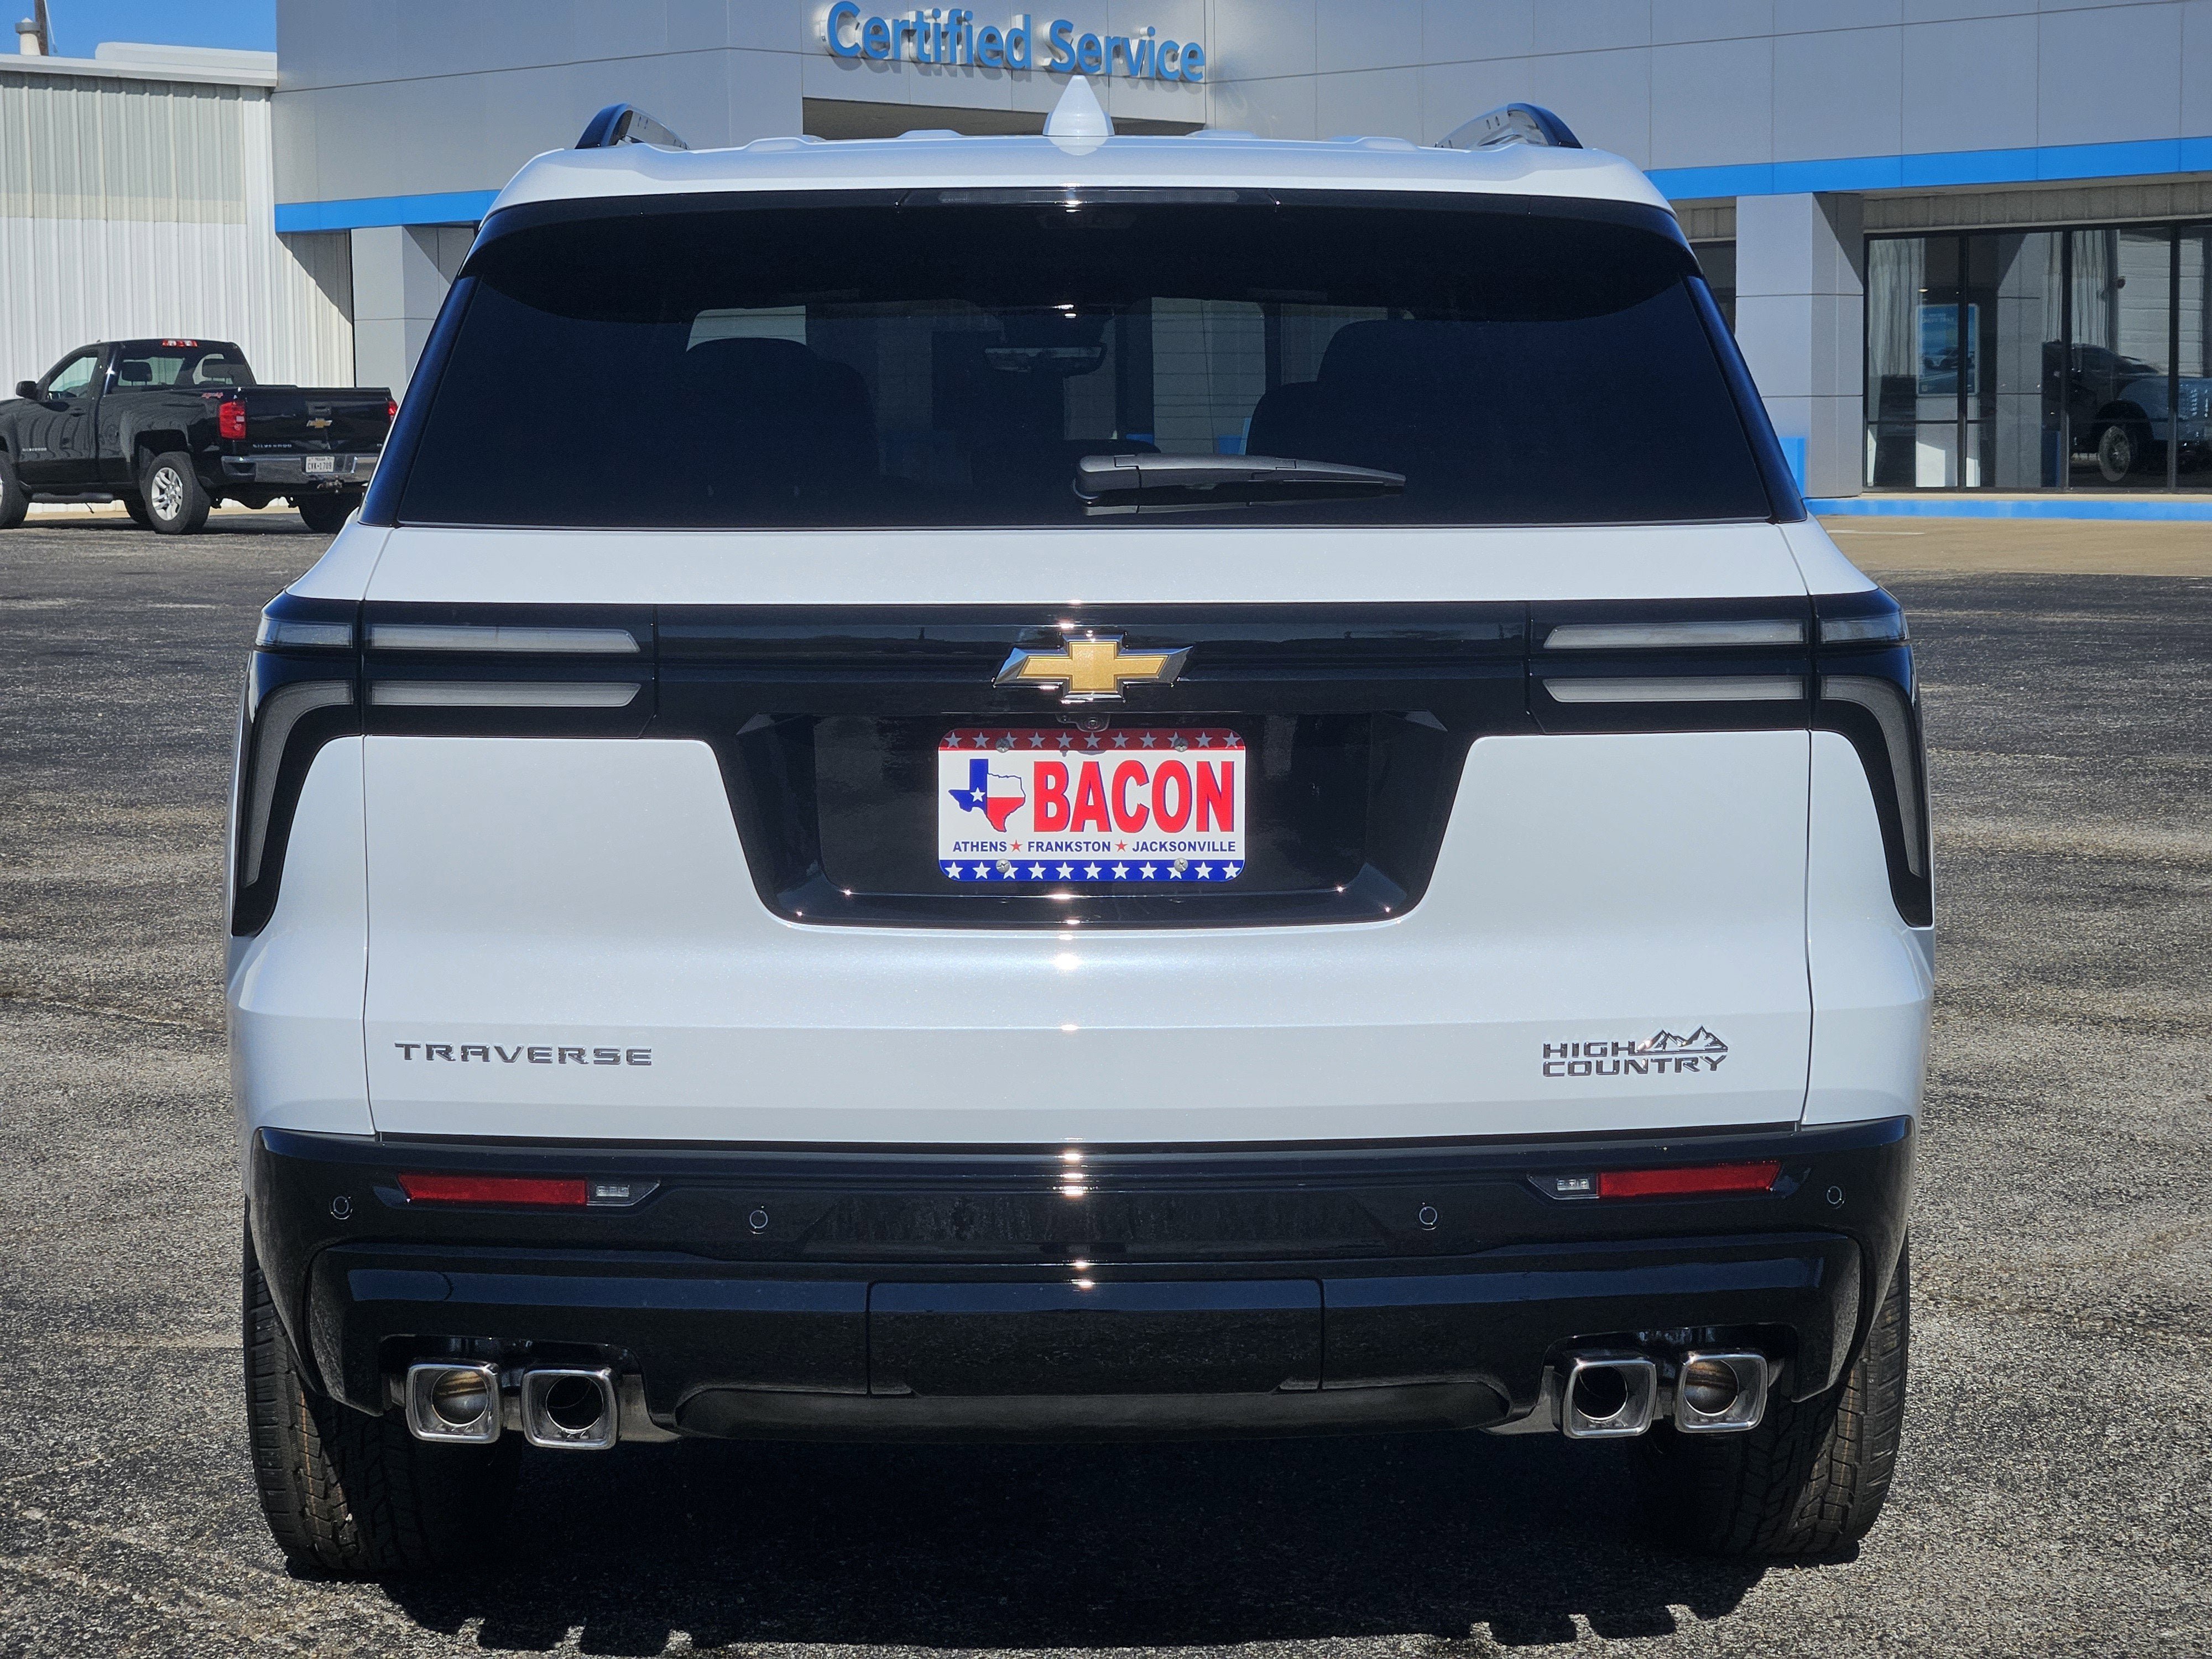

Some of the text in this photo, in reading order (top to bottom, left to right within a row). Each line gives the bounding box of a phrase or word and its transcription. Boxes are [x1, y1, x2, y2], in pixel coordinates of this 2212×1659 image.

[827, 1, 1205, 82] Certified Service
[1033, 759, 1235, 833] BACON
[952, 841, 1237, 852] ATHENS FRANKSTON JACKSONVILLE
[394, 1041, 652, 1066] TRAVERSE
[1543, 1040, 1635, 1058] HIGH
[1543, 1055, 1727, 1077] COUNTRY
